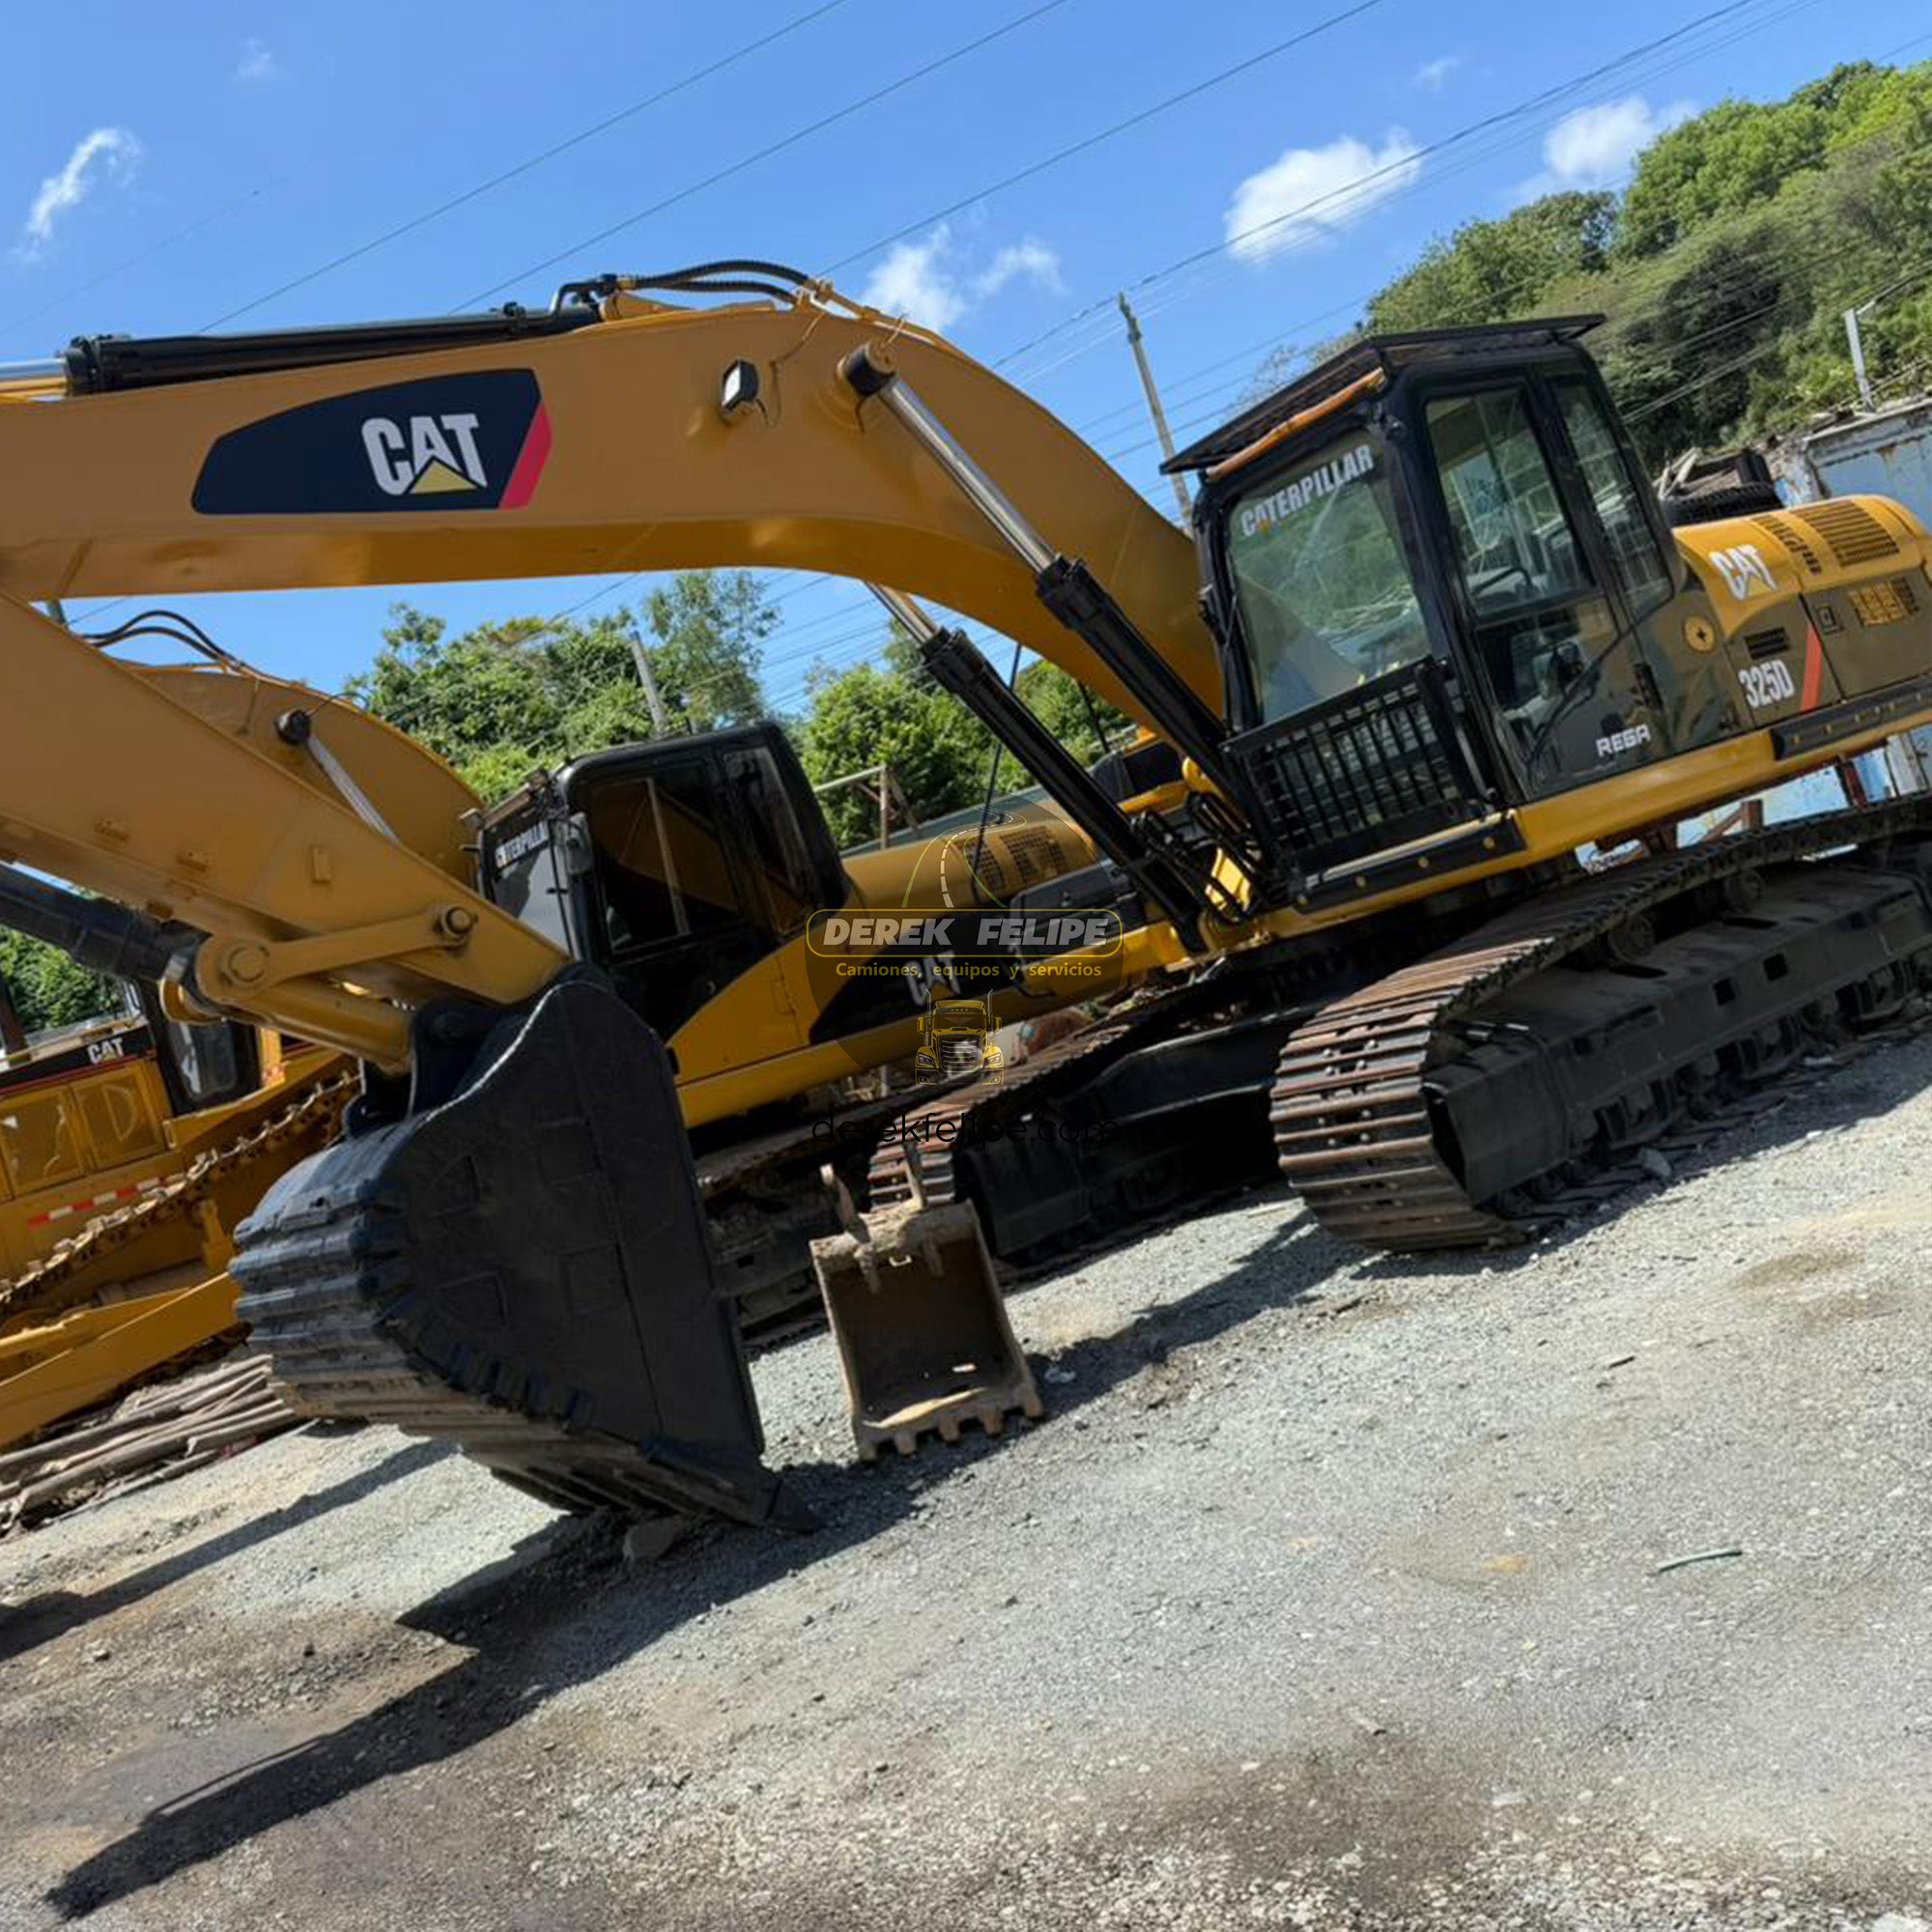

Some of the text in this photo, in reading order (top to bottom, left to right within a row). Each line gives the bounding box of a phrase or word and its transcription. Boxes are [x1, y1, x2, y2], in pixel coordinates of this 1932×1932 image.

[361, 413, 487, 496] CAT
[1241, 445, 1374, 536] CATERPILLAR
[1709, 544, 1777, 600] CAT
[1739, 660, 1795, 708] 325D
[905, 951, 961, 1006] CAT
[87, 1037, 125, 1065] CAT
